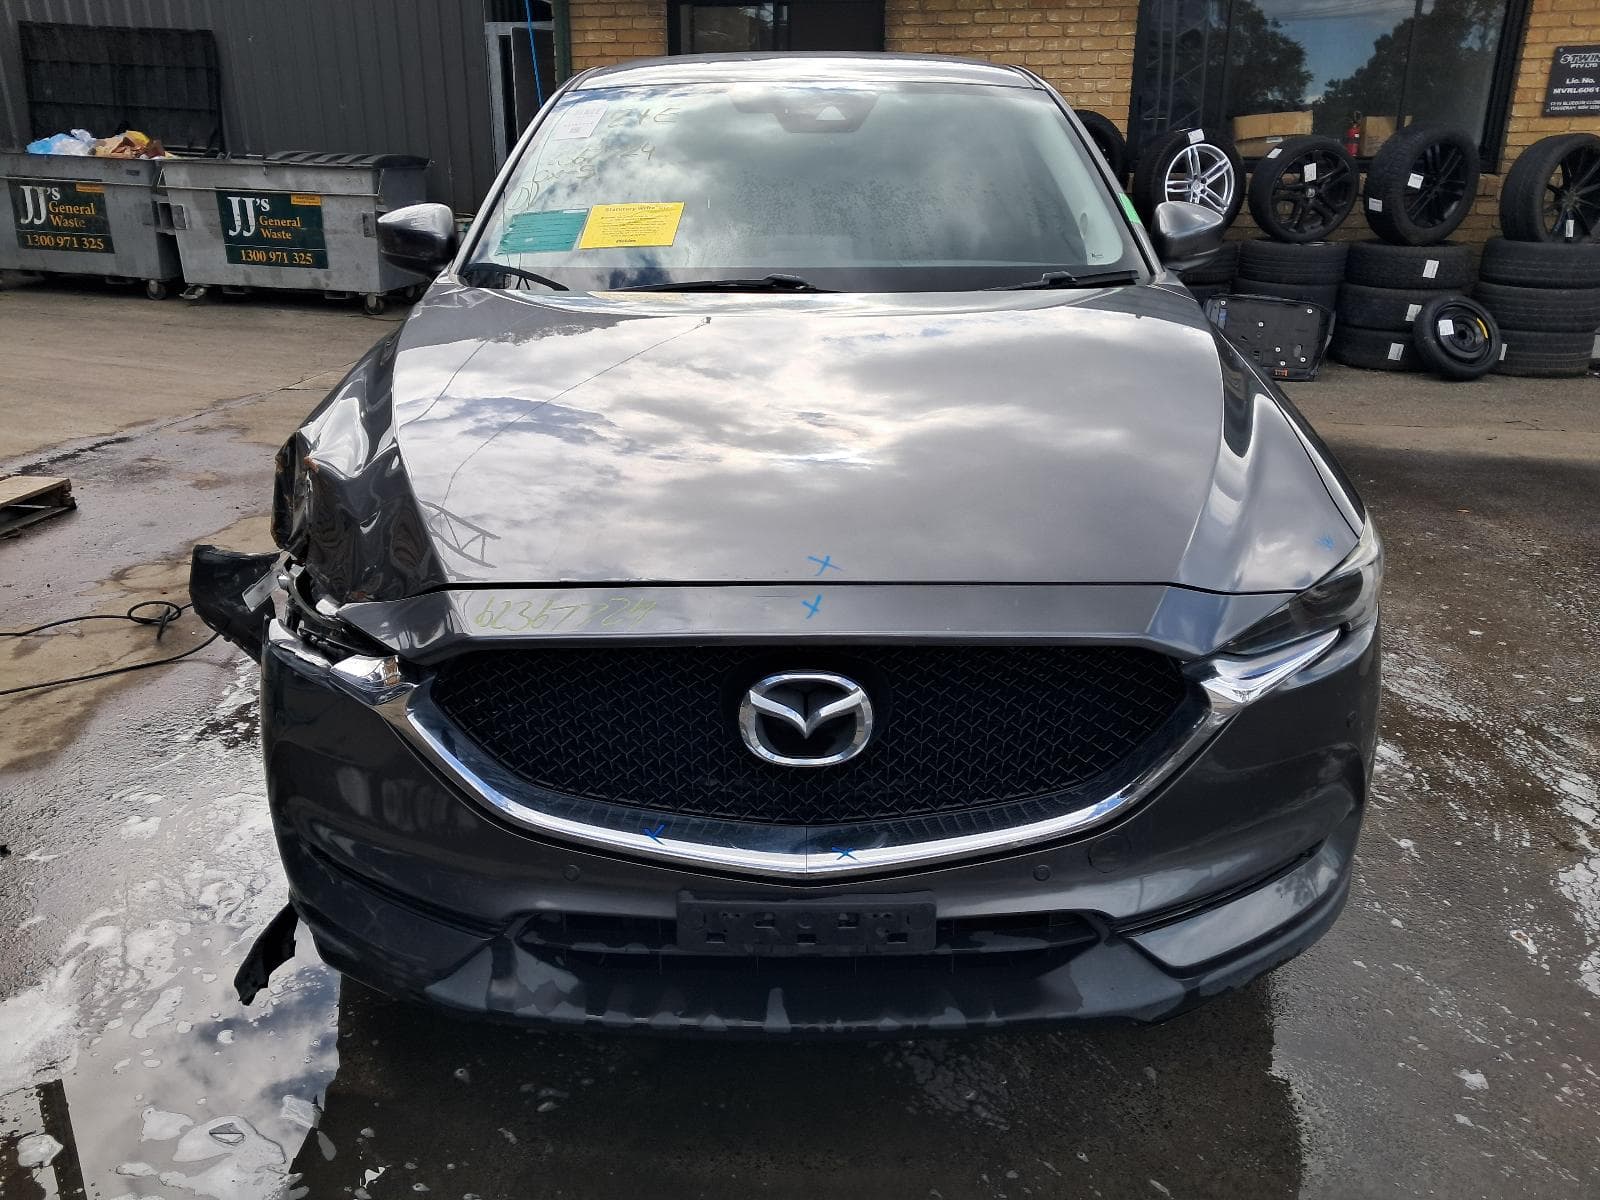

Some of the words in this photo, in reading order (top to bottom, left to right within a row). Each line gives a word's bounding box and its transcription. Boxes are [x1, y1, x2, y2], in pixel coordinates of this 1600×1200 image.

[48, 200, 96, 215] General
[49, 214, 86, 228] Waste
[259, 215, 301, 227] General
[260, 228, 292, 240] Waste
[26, 234, 54, 247] 1300
[57, 236, 79, 248] 971
[81, 237, 104, 250] 325
[240, 249, 266, 262] 1300
[269, 251, 289, 264] 971
[292, 252, 313, 265] 325
